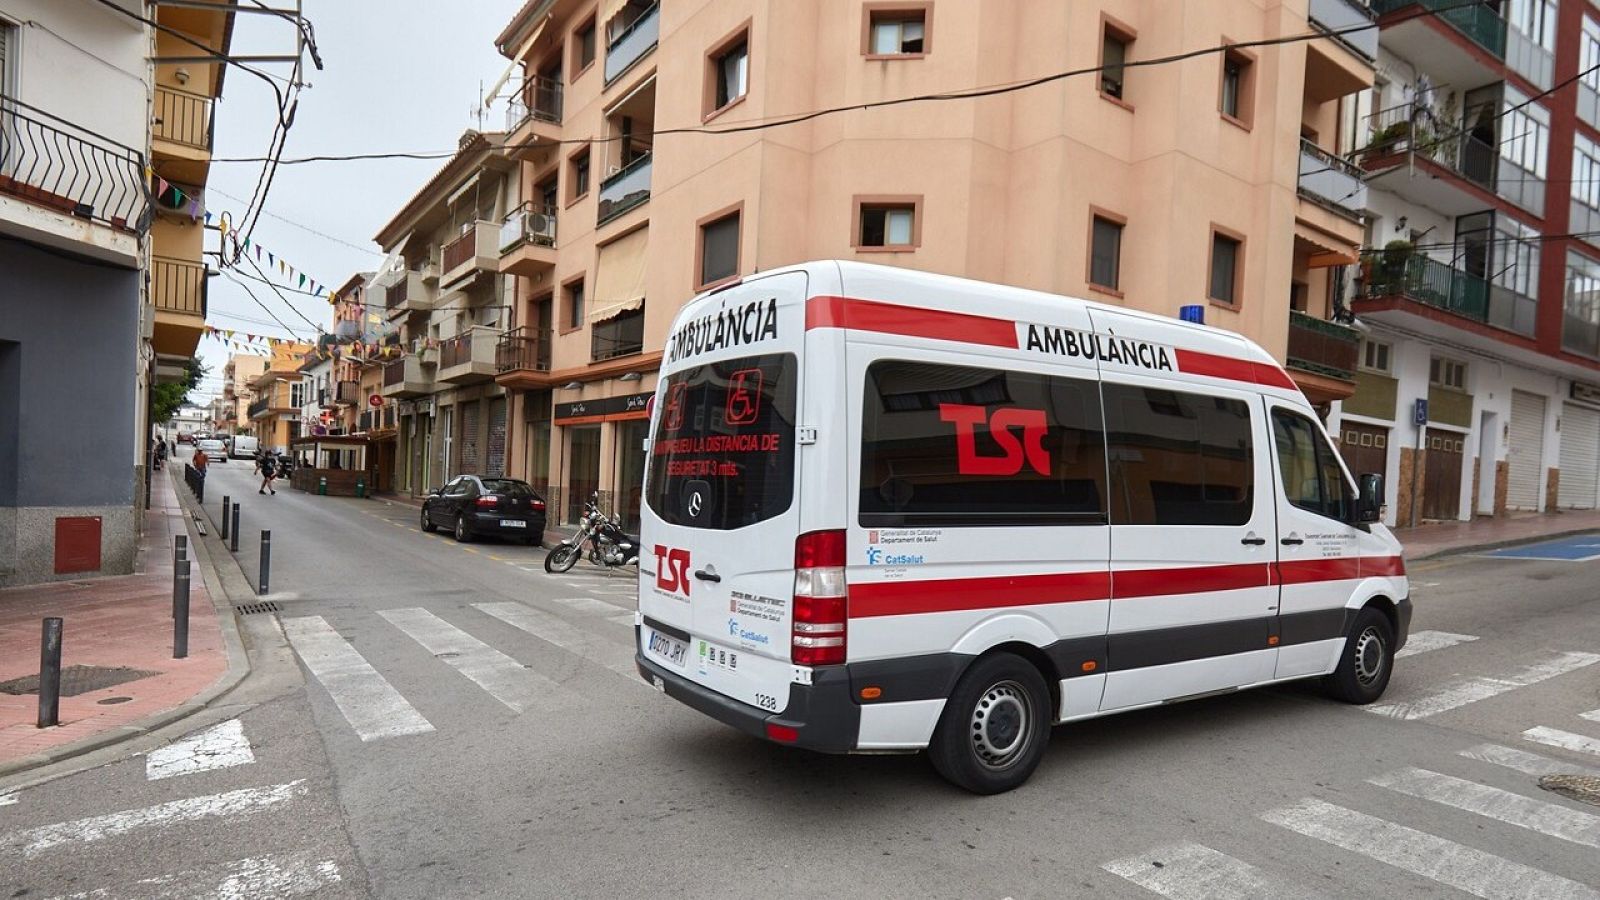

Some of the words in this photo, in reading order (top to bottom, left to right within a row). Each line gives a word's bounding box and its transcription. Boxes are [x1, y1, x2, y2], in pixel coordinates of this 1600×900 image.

[1026, 324, 1173, 372] AMBULÀNCIA
[694, 437, 705, 452] LA
[706, 434, 758, 452] DISTANCIA
[761, 434, 780, 451] DE
[711, 460, 717, 475] 3
[881, 537, 915, 545] Departament
[885, 555, 924, 565] CatSalut
[653, 634, 671, 656] 0270
[740, 629, 769, 645] CatSalut
[755, 693, 777, 710] 1238
